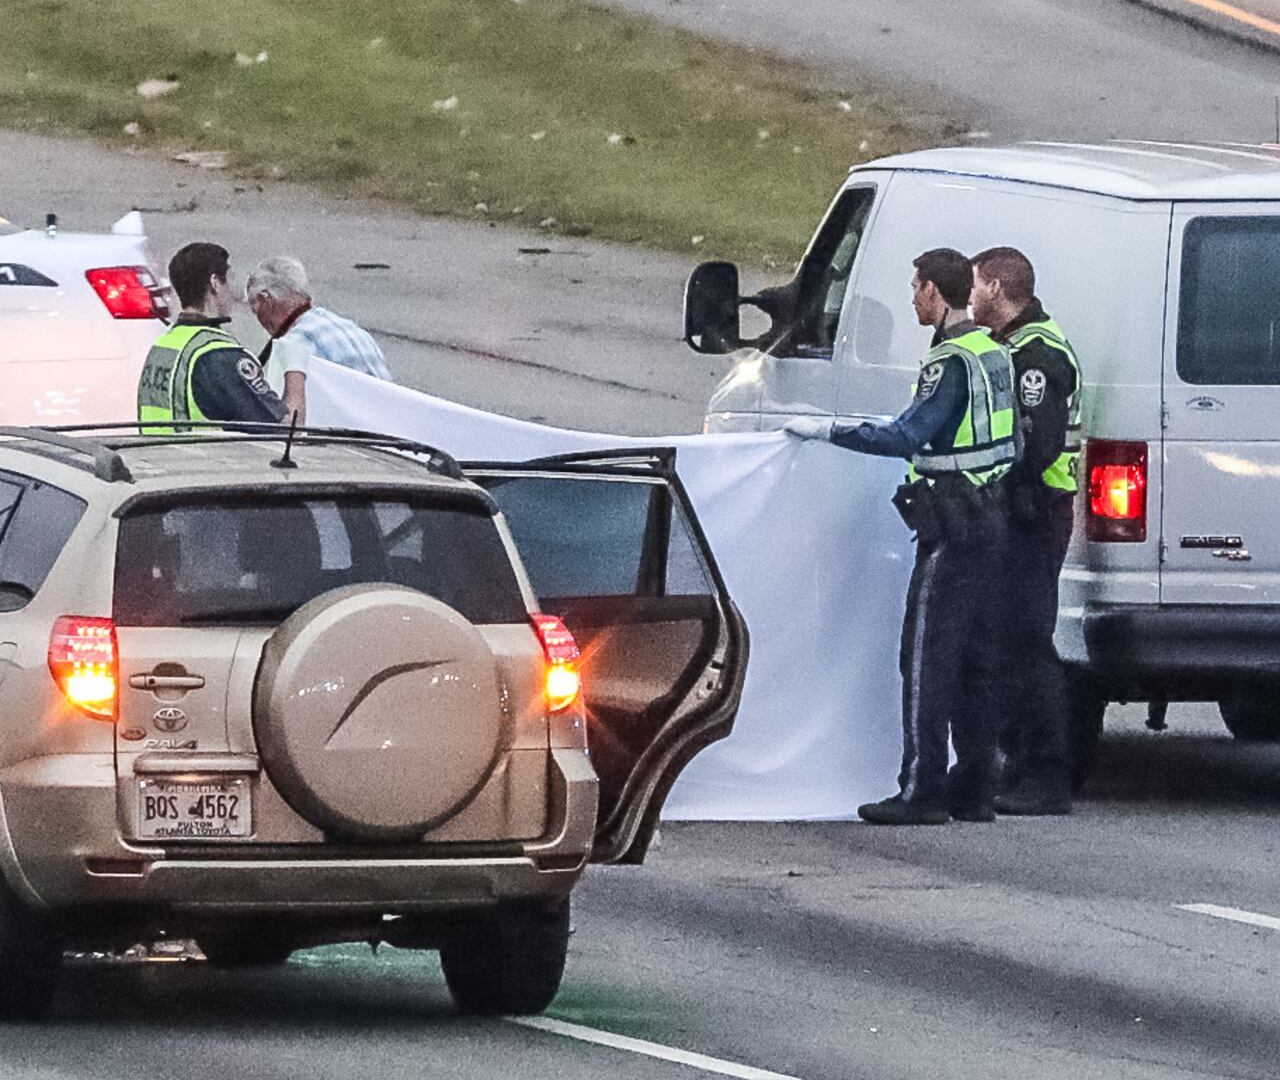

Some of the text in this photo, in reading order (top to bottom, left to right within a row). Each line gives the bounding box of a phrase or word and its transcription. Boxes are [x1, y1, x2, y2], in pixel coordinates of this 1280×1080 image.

[143, 739, 198, 750] RAV4
[194, 795, 239, 820] 4562
[177, 821, 213, 829] FULTON
[195, 827, 231, 836] TOYOTA
